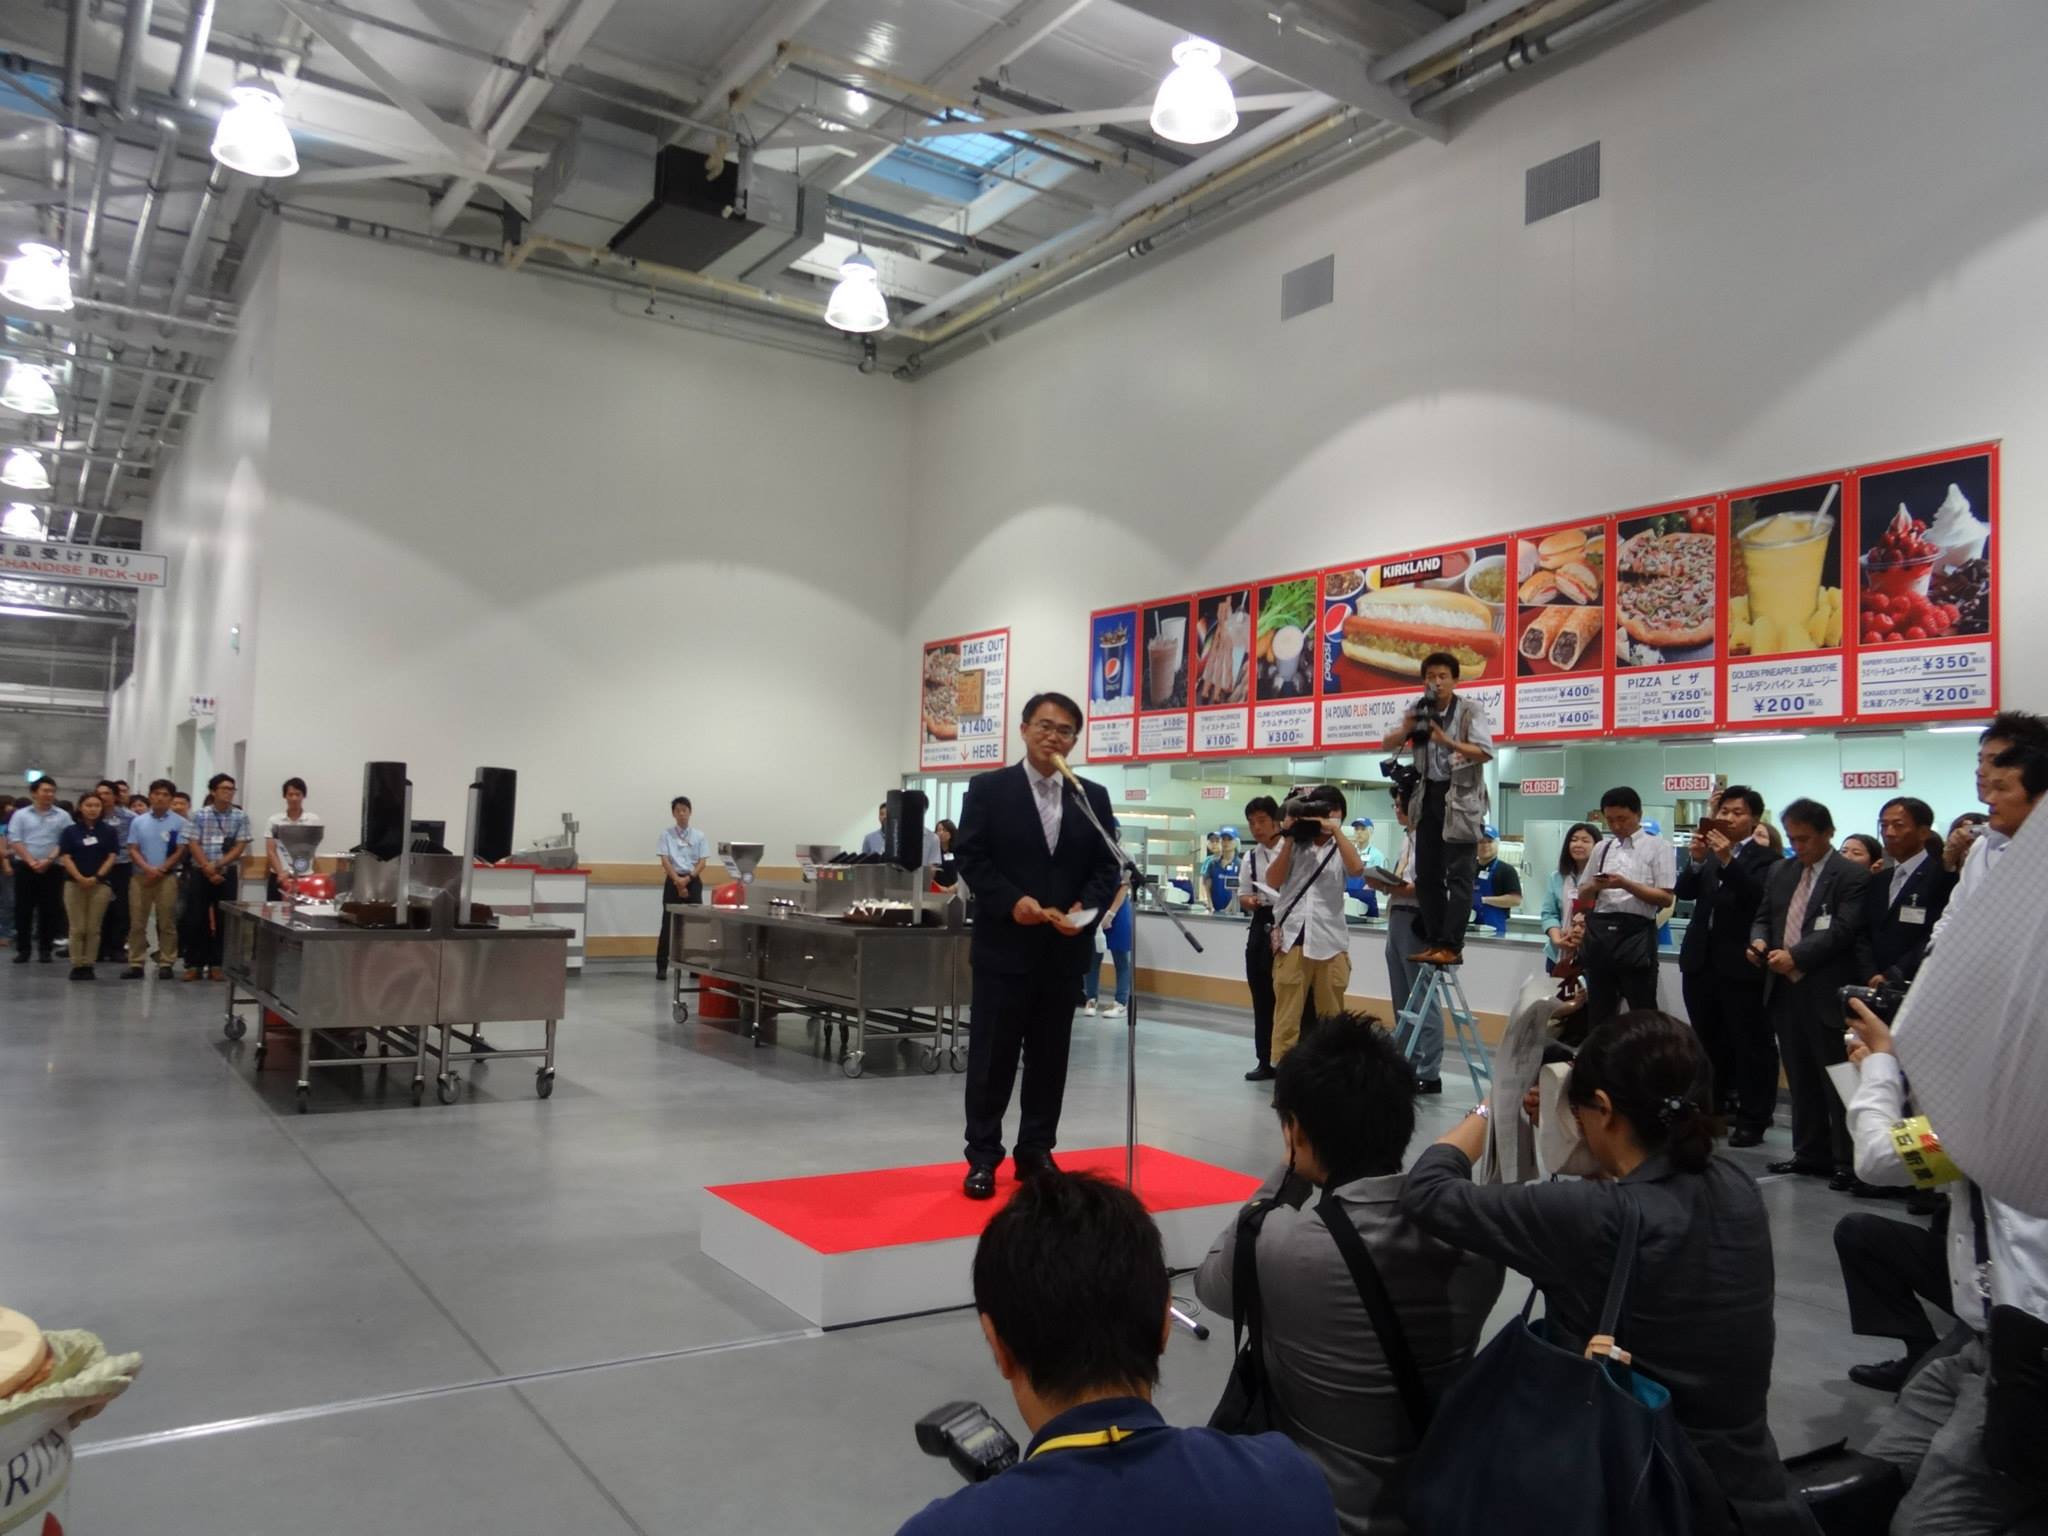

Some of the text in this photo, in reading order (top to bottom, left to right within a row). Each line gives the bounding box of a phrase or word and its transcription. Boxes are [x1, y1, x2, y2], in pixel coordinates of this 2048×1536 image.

[88, 566, 159, 583] PICK-UP
[1383, 557, 1441, 579] KIRKLAND
[963, 638, 1004, 657] TAKE OUT
[1324, 643, 1333, 682] pepsi
[1923, 655, 1969, 670] ¥350
[1732, 662, 1838, 680] GOLDEN PINEAPPLE SMOOTHIE
[1627, 676, 1662, 689] PIZZA
[1798, 676, 1838, 687] スムージー
[1559, 686, 1590, 698] ¥400
[1670, 690, 1701, 701] ¥250
[1923, 687, 1969, 701] ¥200
[1333, 704, 1352, 719] POUND
[1353, 703, 1368, 718] PLUS
[1369, 702, 1381, 717] HOT
[1382, 701, 1395, 715] DOG
[1753, 696, 1805, 713] ¥200
[1559, 712, 1589, 723] ¥400
[1662, 708, 1700, 720] ¥1400
[961, 718, 993, 734] ¥1400
[1261, 718, 1307, 728] クラムチャウダー
[1206, 735, 1231, 746] ¥100
[1268, 731, 1295, 742] ¥300
[972, 743, 999, 759] HERE
[1523, 781, 1557, 793] CLOSED
[1667, 777, 1708, 791] CLOSED
[1845, 773, 1895, 787] CLOSED
